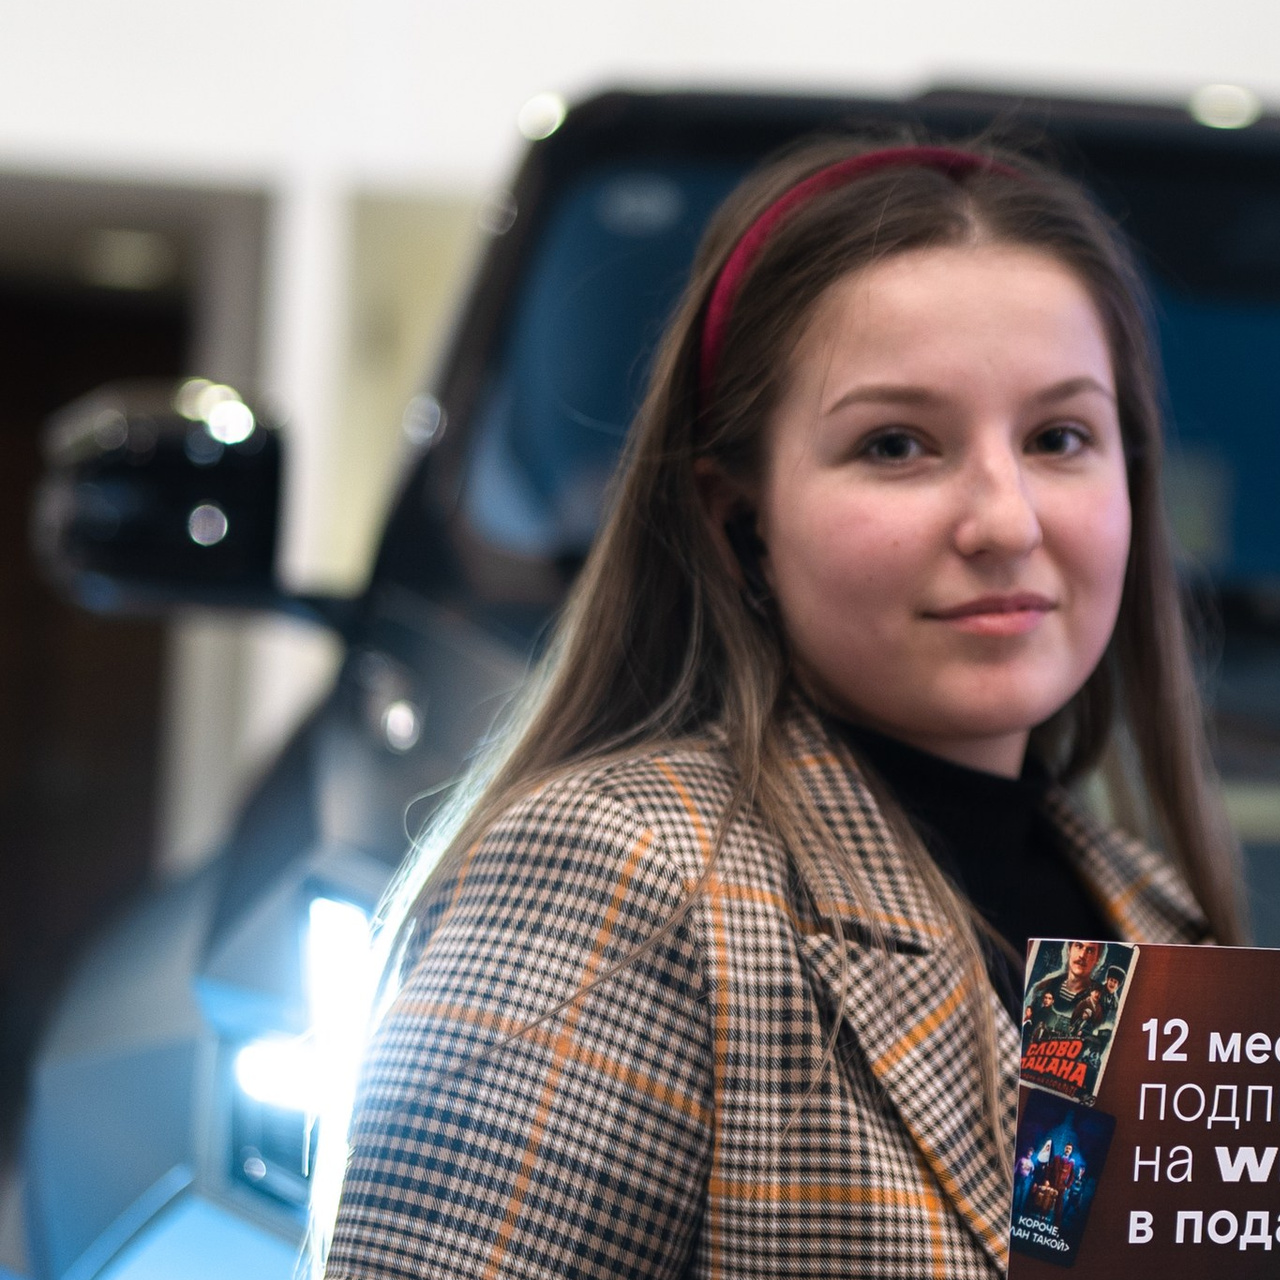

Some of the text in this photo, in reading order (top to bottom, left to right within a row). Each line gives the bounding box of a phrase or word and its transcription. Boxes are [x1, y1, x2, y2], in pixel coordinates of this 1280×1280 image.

[1026, 1040, 1083, 1060] СЛОВО
[1141, 1018, 1190, 1062] 12
[1133, 1145, 1194, 1183] на
[1018, 1215, 1060, 1238] КОРОЧЕ,
[1128, 1210, 1155, 1244] в
